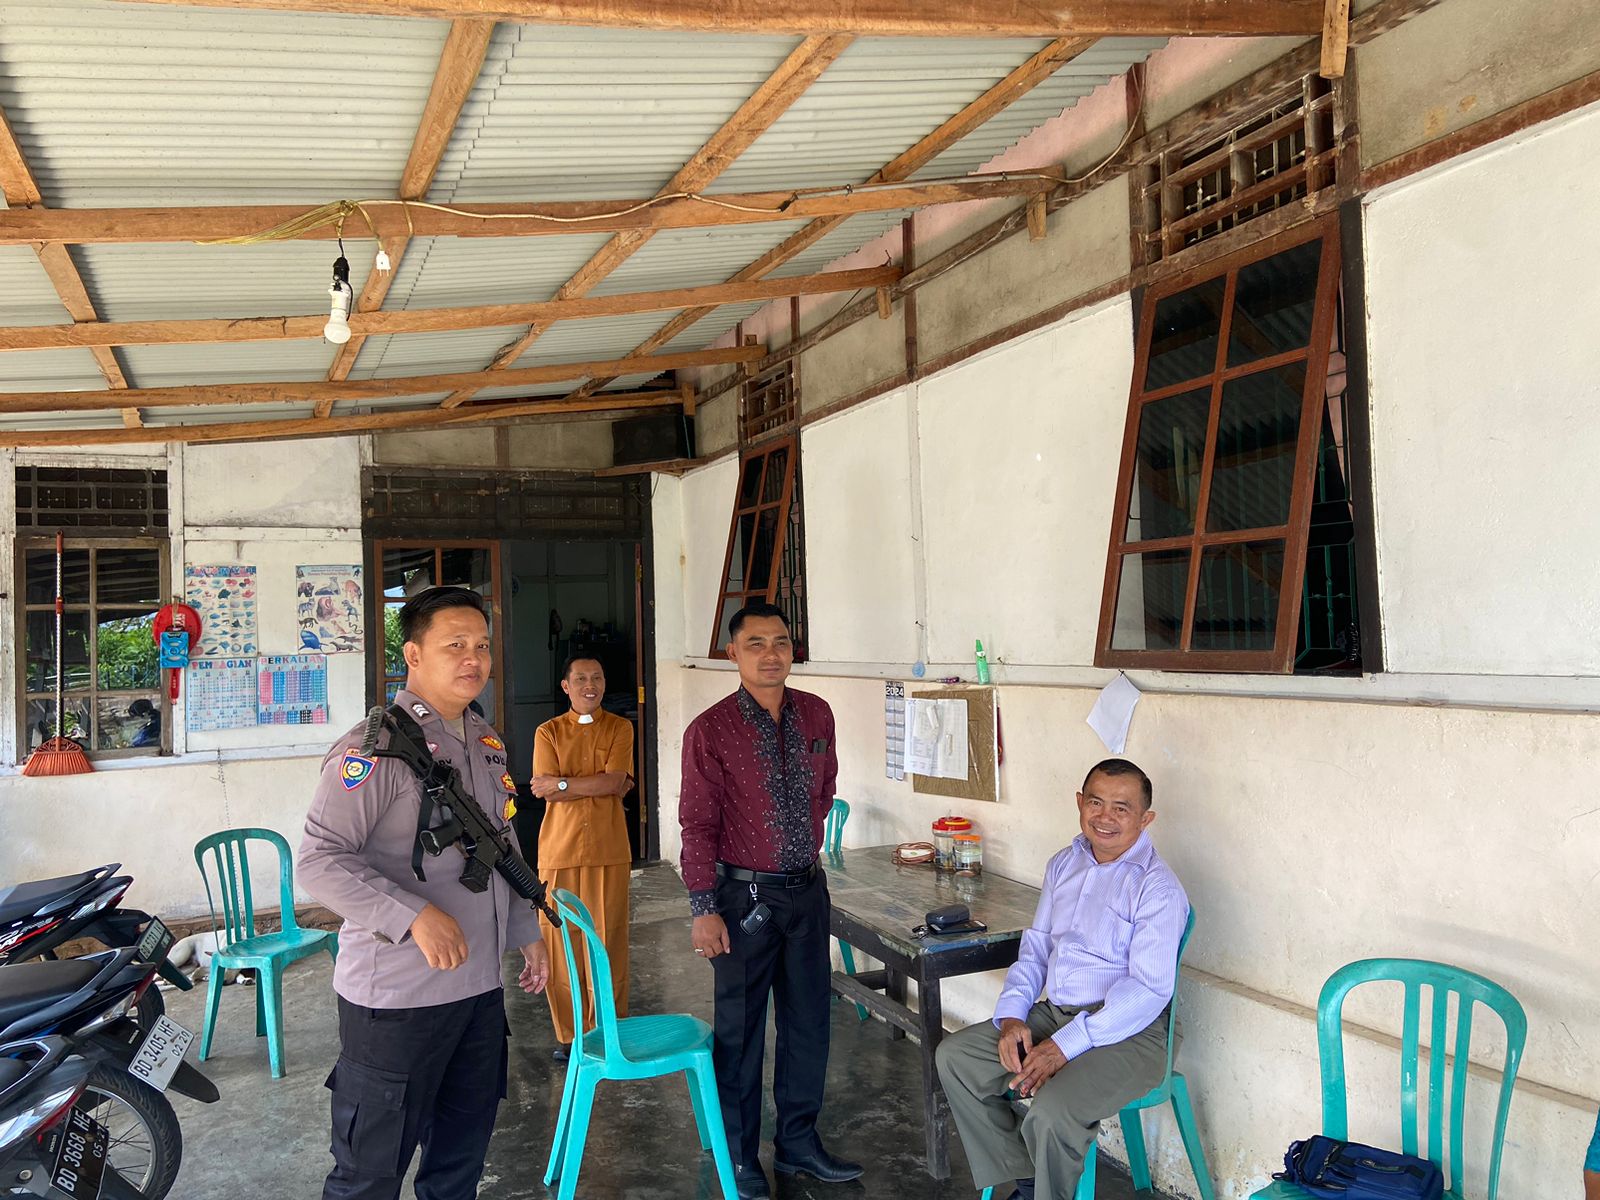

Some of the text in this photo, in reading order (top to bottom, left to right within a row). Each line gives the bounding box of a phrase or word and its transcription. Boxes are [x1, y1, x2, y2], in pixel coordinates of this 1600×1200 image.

[260, 655, 325, 665] PERKALIAN
[886, 686, 904, 697] 2024
[134, 1019, 175, 1077] BD 3405 HF
[171, 1044, 183, 1057] 02
[63, 1132, 86, 1168] 3668
[56, 1167, 78, 1192] BD
